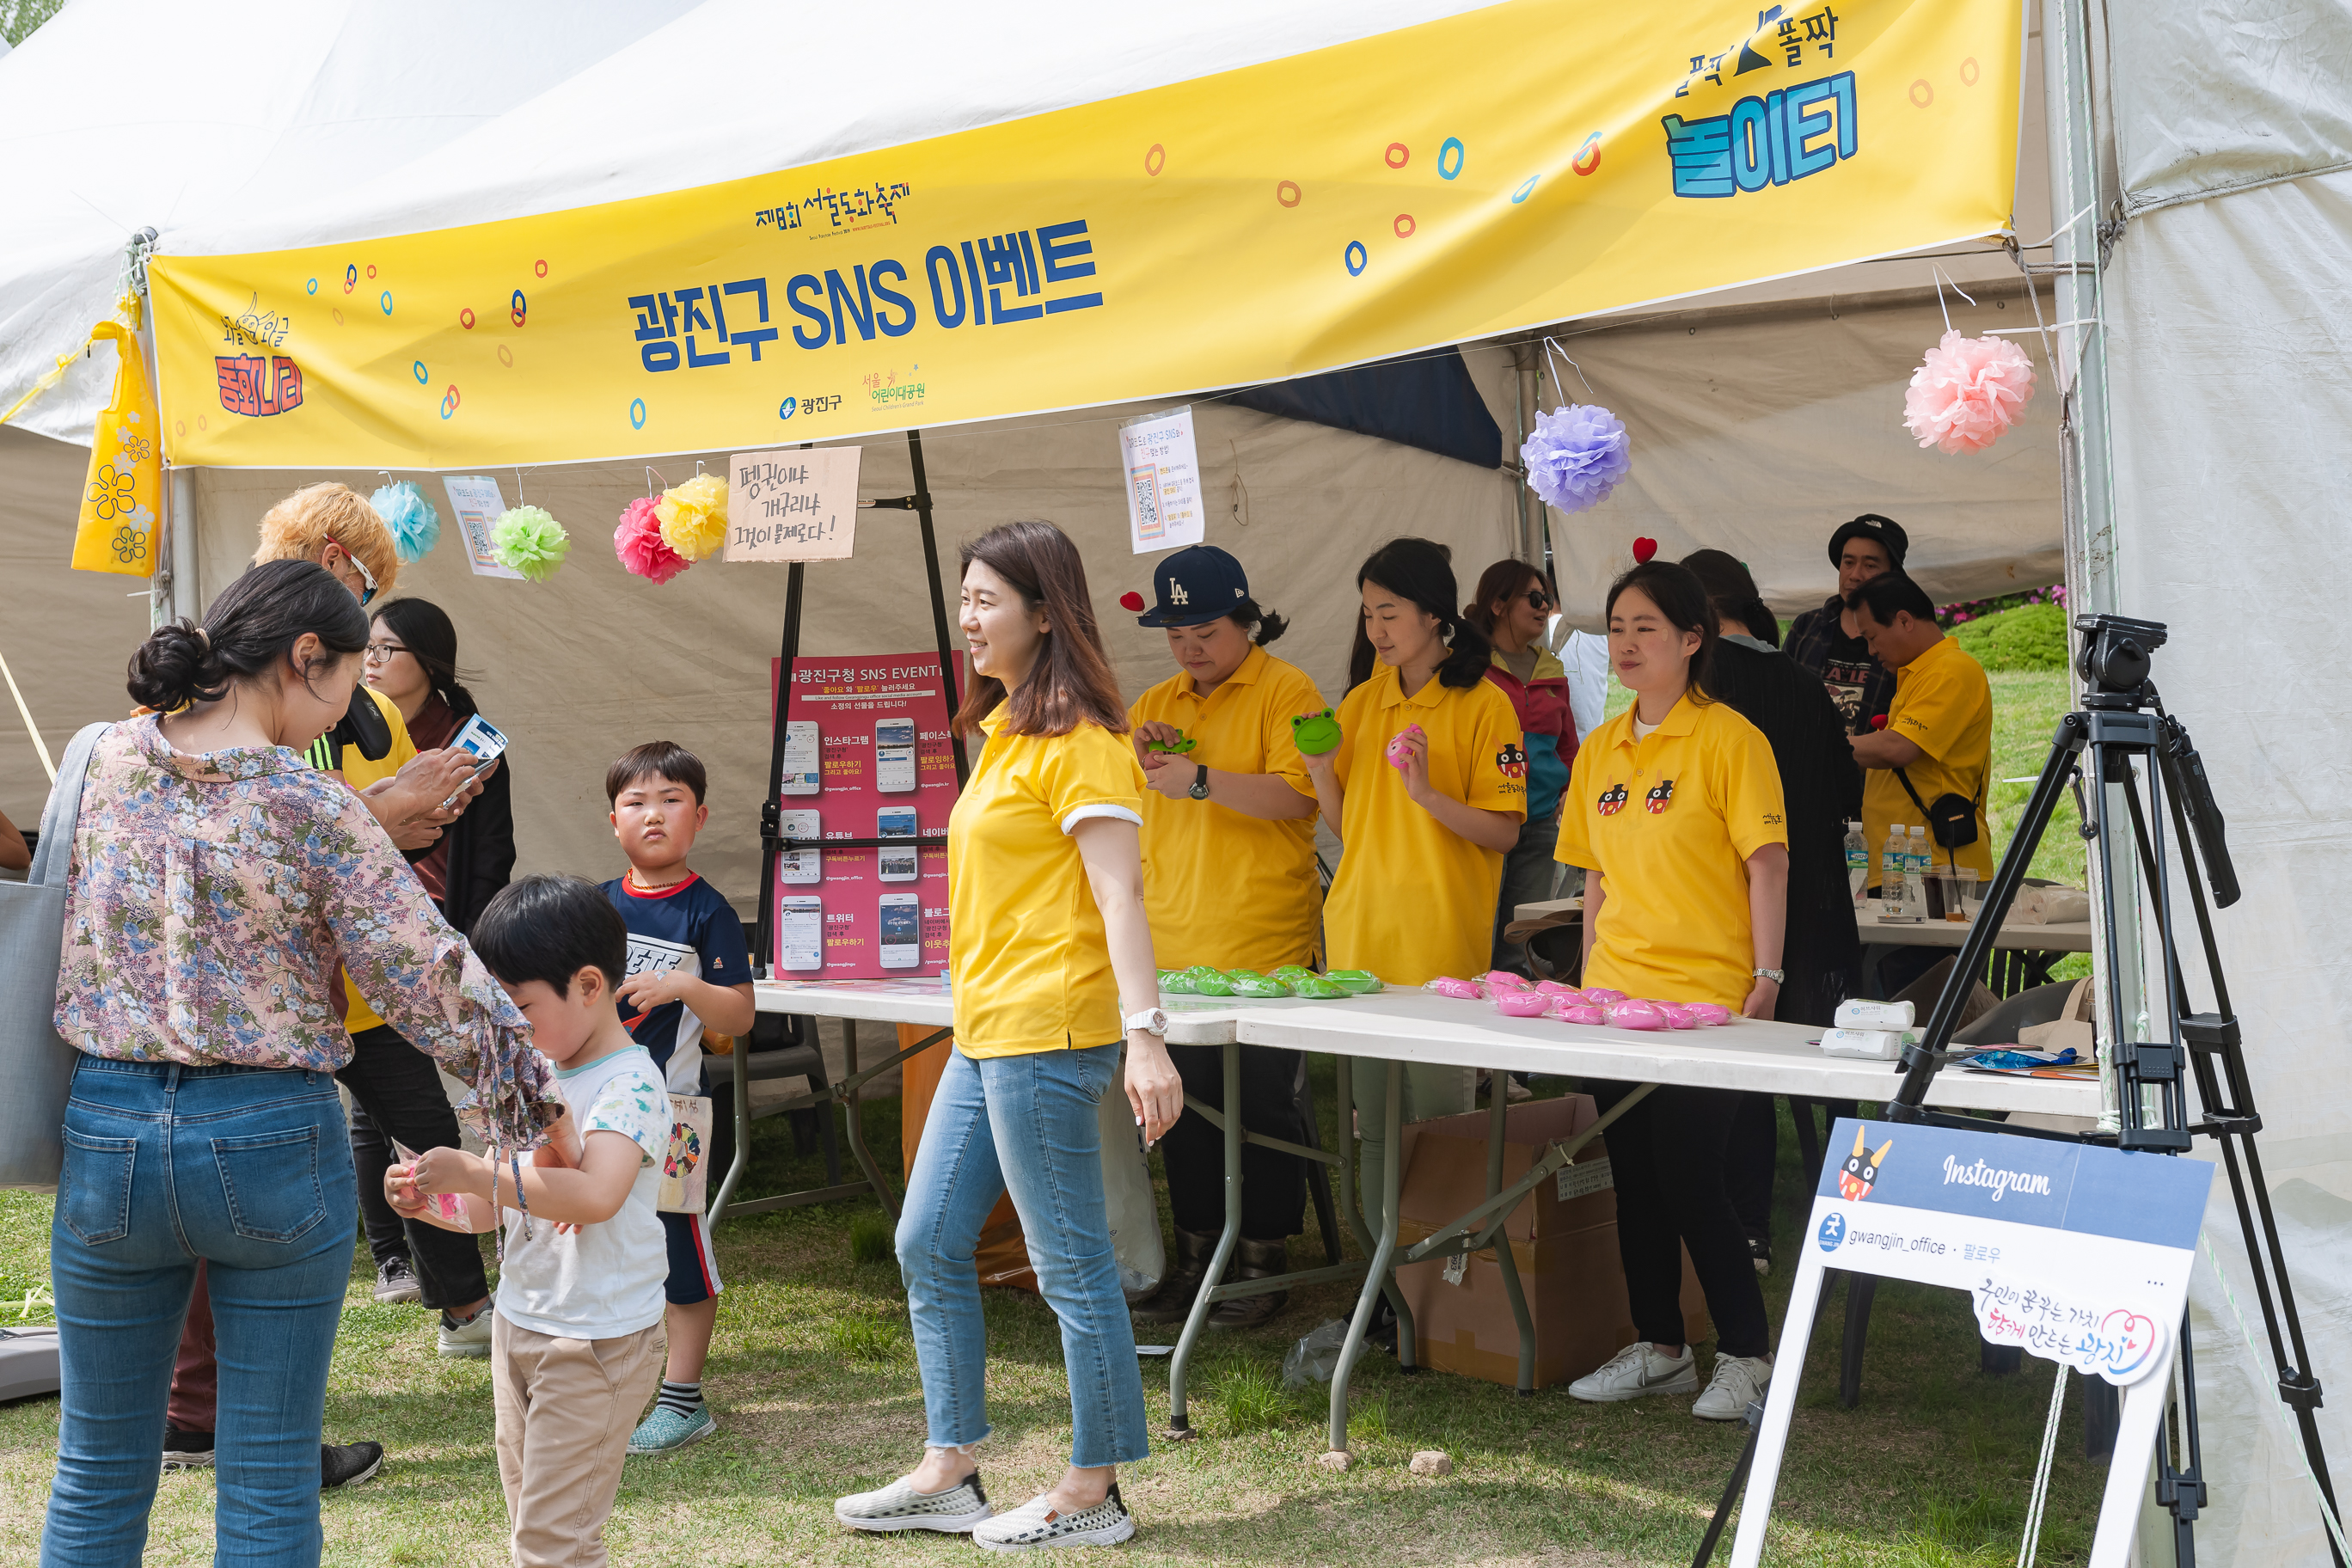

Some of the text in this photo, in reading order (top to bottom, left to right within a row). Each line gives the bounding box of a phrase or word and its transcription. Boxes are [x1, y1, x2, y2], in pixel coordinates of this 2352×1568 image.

[1777, 6, 1839, 68] 폴짝
[1661, 70, 1859, 199] 놀이터
[756, 181, 910, 230] 제8회 서울동화축제
[628, 219, 1104, 372] 광진구 SNS 이벤트
[260, 316, 289, 348] 와글
[215, 352, 303, 417] 동화나라
[861, 372, 881, 397] 서울
[871, 382, 926, 404] 어린이대공원
[800, 395, 842, 415] 광진구
[1147, 431, 1164, 445] 광진구
[739, 462, 810, 500] 펭귄이냐
[762, 492, 822, 518] 개구리냐
[733, 525, 772, 550] 그것이
[1169, 577, 1189, 605] LA
[798, 665, 938, 684] 광진구청 SNS EVENT
[880, 683, 916, 692] 눌러주세요
[830, 700, 908, 711] 소정의 선물을 드립니다!
[824, 735, 869, 746] 인스타그램
[824, 760, 862, 769] 팔로우하기
[825, 913, 854, 923] 트위터
[826, 938, 865, 947] 팔로우하기
[1942, 1154, 2051, 1203] Instagram
[1848, 1228, 2001, 1265] gwangjin_office 팔로우
[2021, 1289, 2065, 1322] 꿈꾸는
[2068, 1307, 2099, 1329] 가치
[1988, 1307, 2026, 1339] 함께
[2028, 1324, 2074, 1356] 만드는
